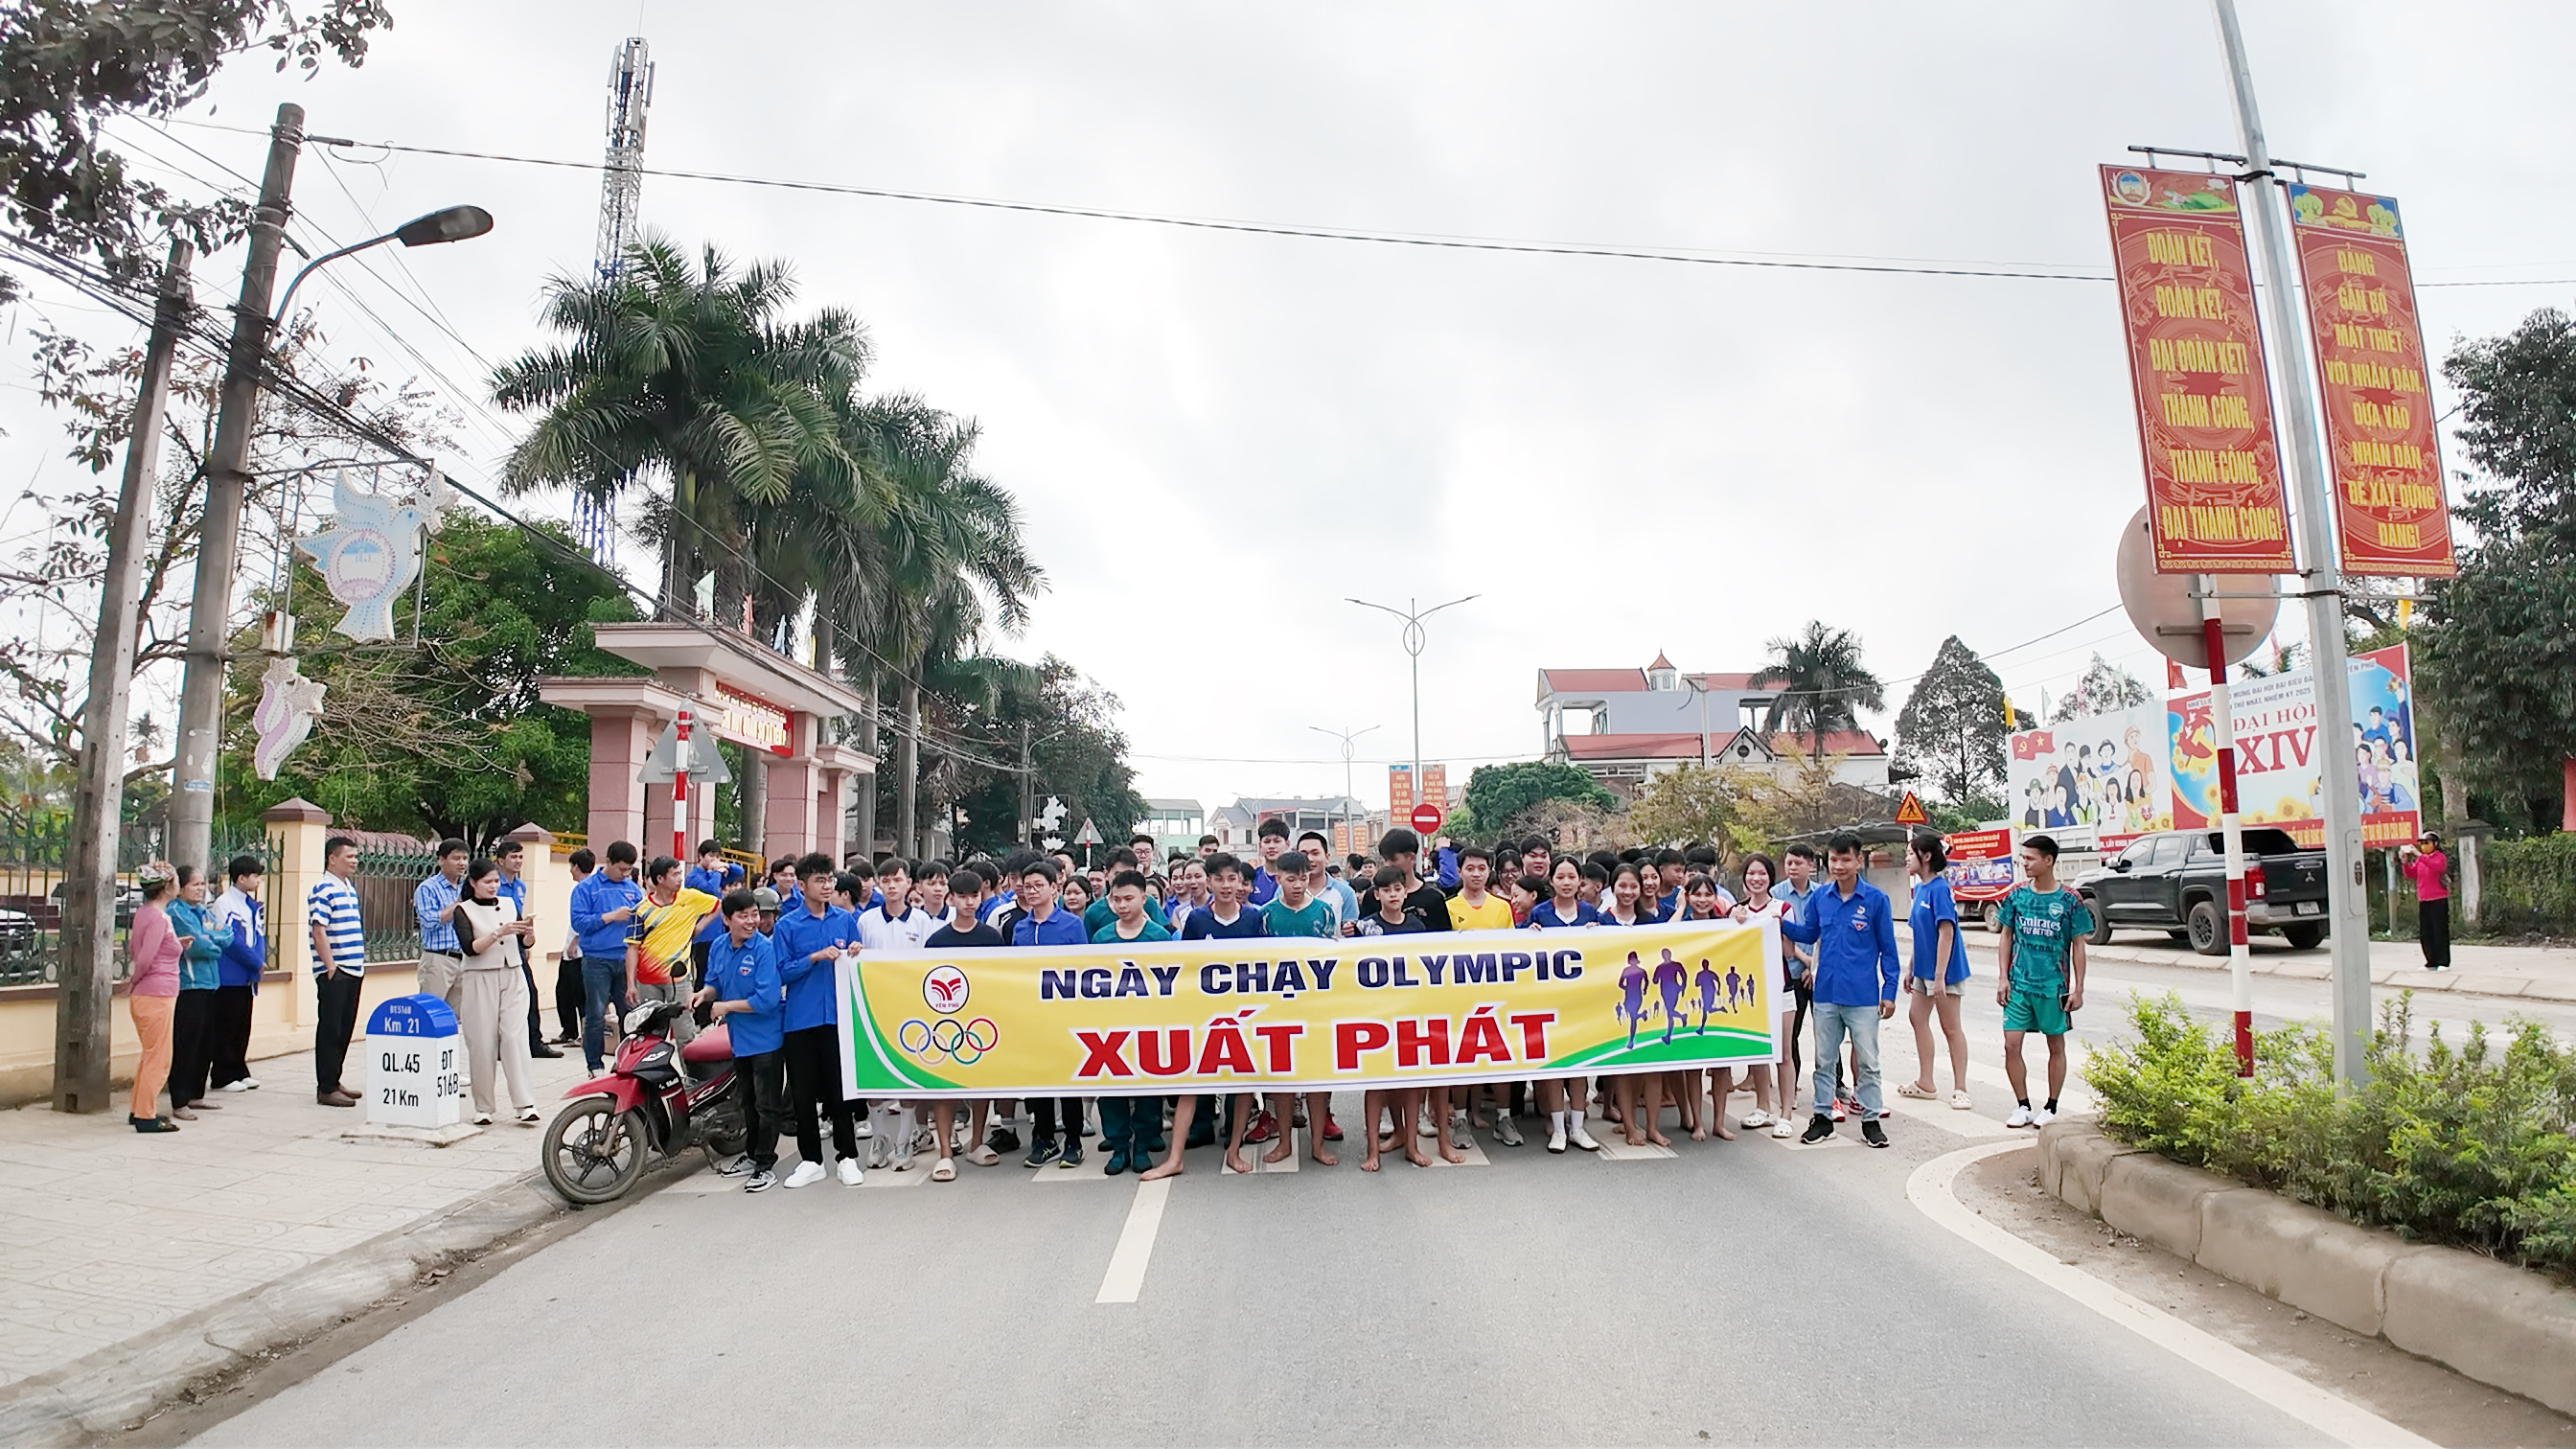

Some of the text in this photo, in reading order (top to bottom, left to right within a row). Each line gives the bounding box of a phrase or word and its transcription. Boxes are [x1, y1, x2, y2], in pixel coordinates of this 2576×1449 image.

[2147, 225, 2220, 271] ĐOÀN KẾT,
[2336, 242, 2376, 276] ĐẢNG
[2155, 277, 2228, 324] ĐOÀN KẾT,
[2337, 280, 2367, 312] GẮN
[2334, 320, 2403, 353] MẬT THIẾT
[2150, 331, 2249, 379] ĐẠI ĐOÀN KẾT!
[2325, 355, 2425, 395] VỚI NHÂN DÂN,
[2161, 387, 2254, 433] THÀNH CÔNG,
[2352, 401, 2410, 430] DỰA VÀO
[2169, 443, 2262, 487] THÀNH CÔNG,
[2351, 438, 2422, 470] NHÂN DÂN
[2348, 472, 2436, 514] ĐỂ XÂY DỰNG
[2162, 499, 2283, 547] ĐẠI THÀNH CÔNG!
[2378, 513, 2421, 549] ĐẢNG!
[2233, 702, 2316, 732] ĐẠI HỘI
[2235, 725, 2317, 775] XIV
[2018, 916, 2061, 931] Emirates
[1041, 950, 1583, 1000] NGÀY CHẠY OLYMPIC
[384, 1017, 420, 1034] Km 21
[1076, 1006, 1555, 1077] XUẤT PHÁT
[382, 1052, 420, 1073] QL.45
[442, 1049, 453, 1070] ĐT
[437, 1072, 459, 1098] 516B
